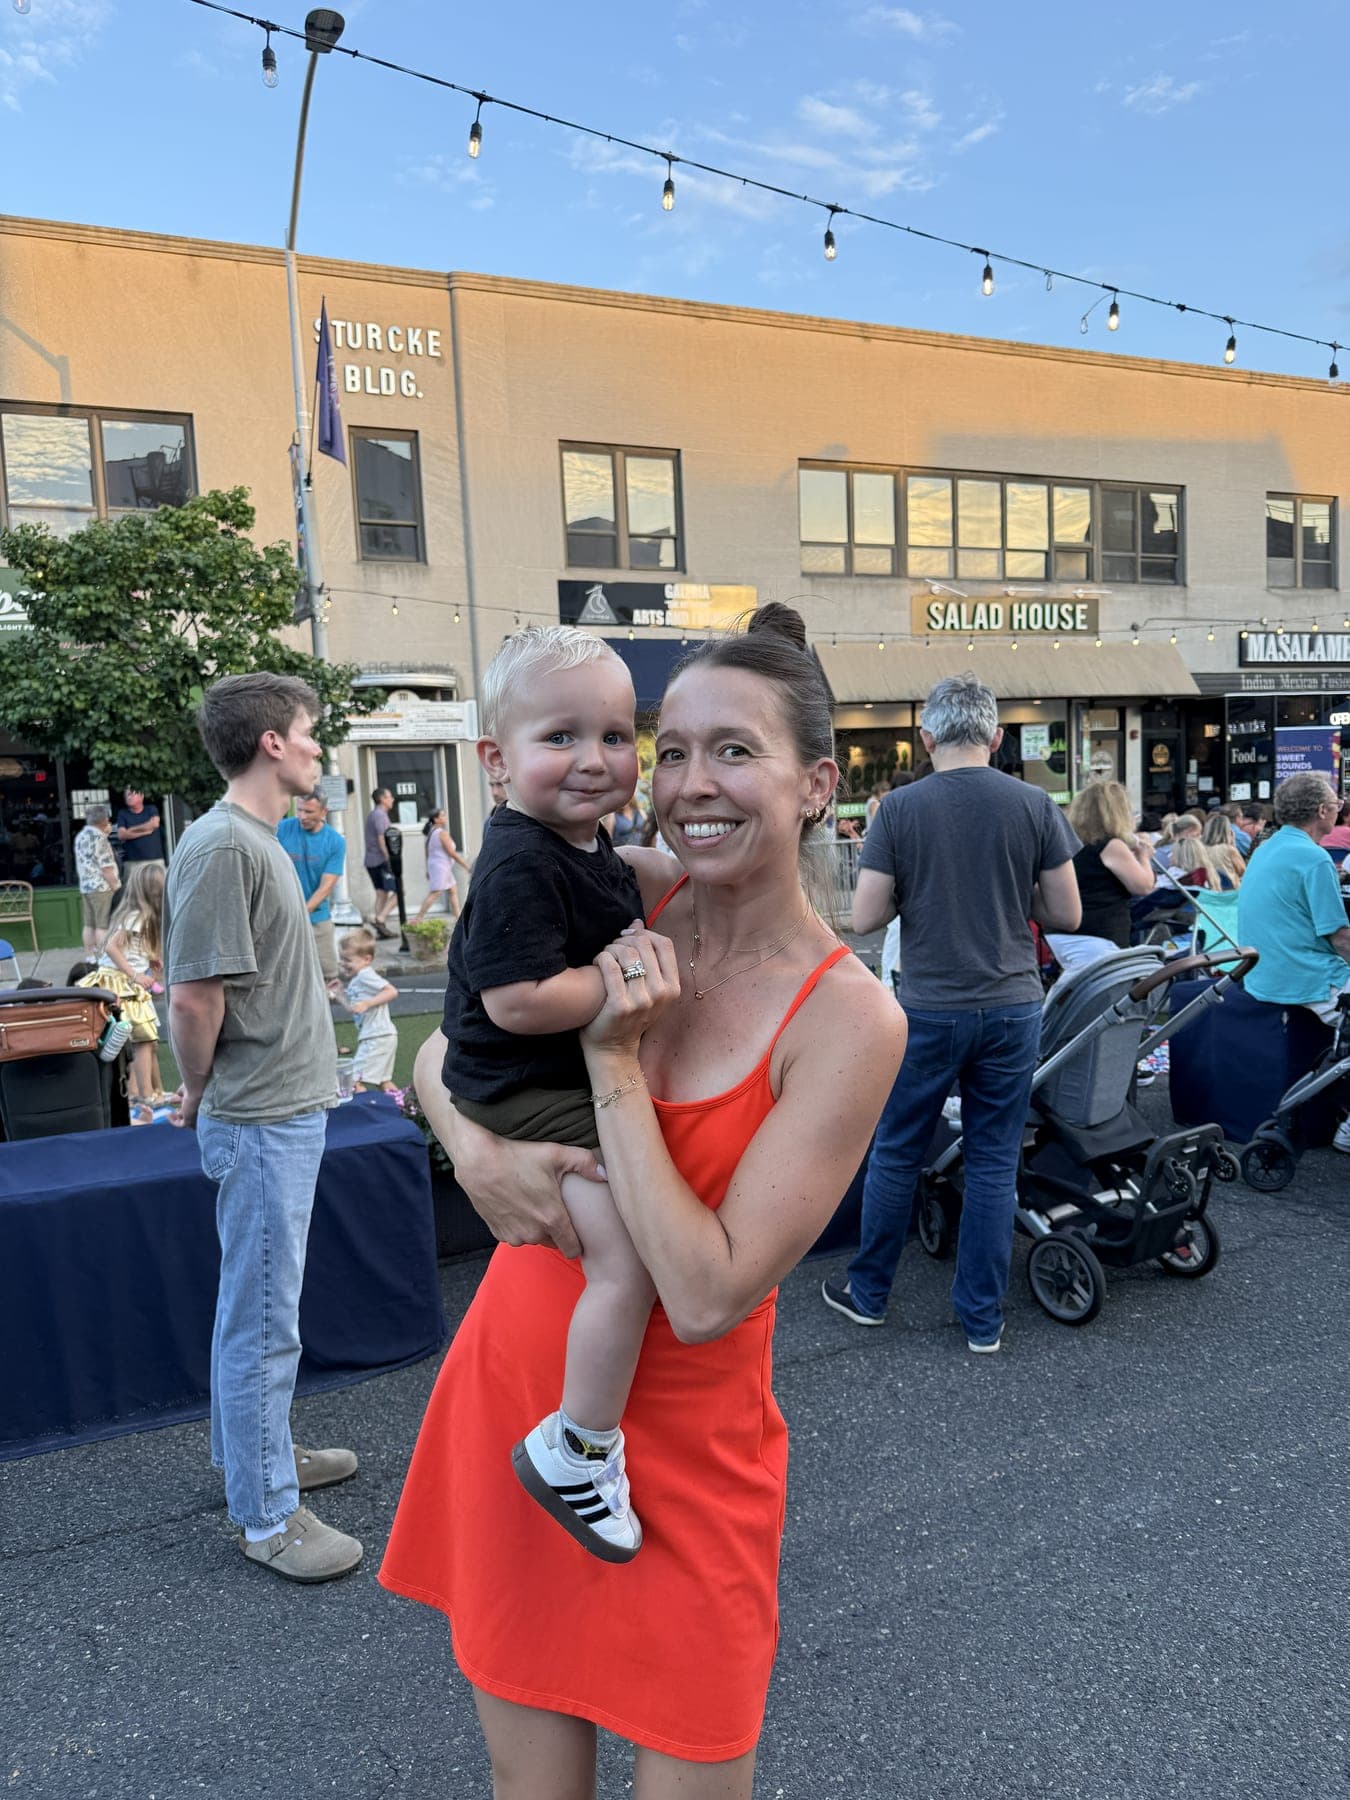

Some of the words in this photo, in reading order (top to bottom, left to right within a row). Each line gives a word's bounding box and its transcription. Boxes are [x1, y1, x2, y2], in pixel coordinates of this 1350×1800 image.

[344, 364, 424, 399] BLDG.
[632, 609, 665, 626] ARTS
[928, 602, 1004, 631] SALAD
[1011, 602, 1089, 631] HOUSE
[1241, 674, 1276, 690] Indian
[1280, 673, 1319, 690] Mexican
[1231, 746, 1256, 764] Food
[1276, 744, 1312, 753] WELCOME
[1313, 744, 1324, 752] TO
[1275, 753, 1306, 762] SWEET
[1275, 761, 1313, 770] SOUNDS
